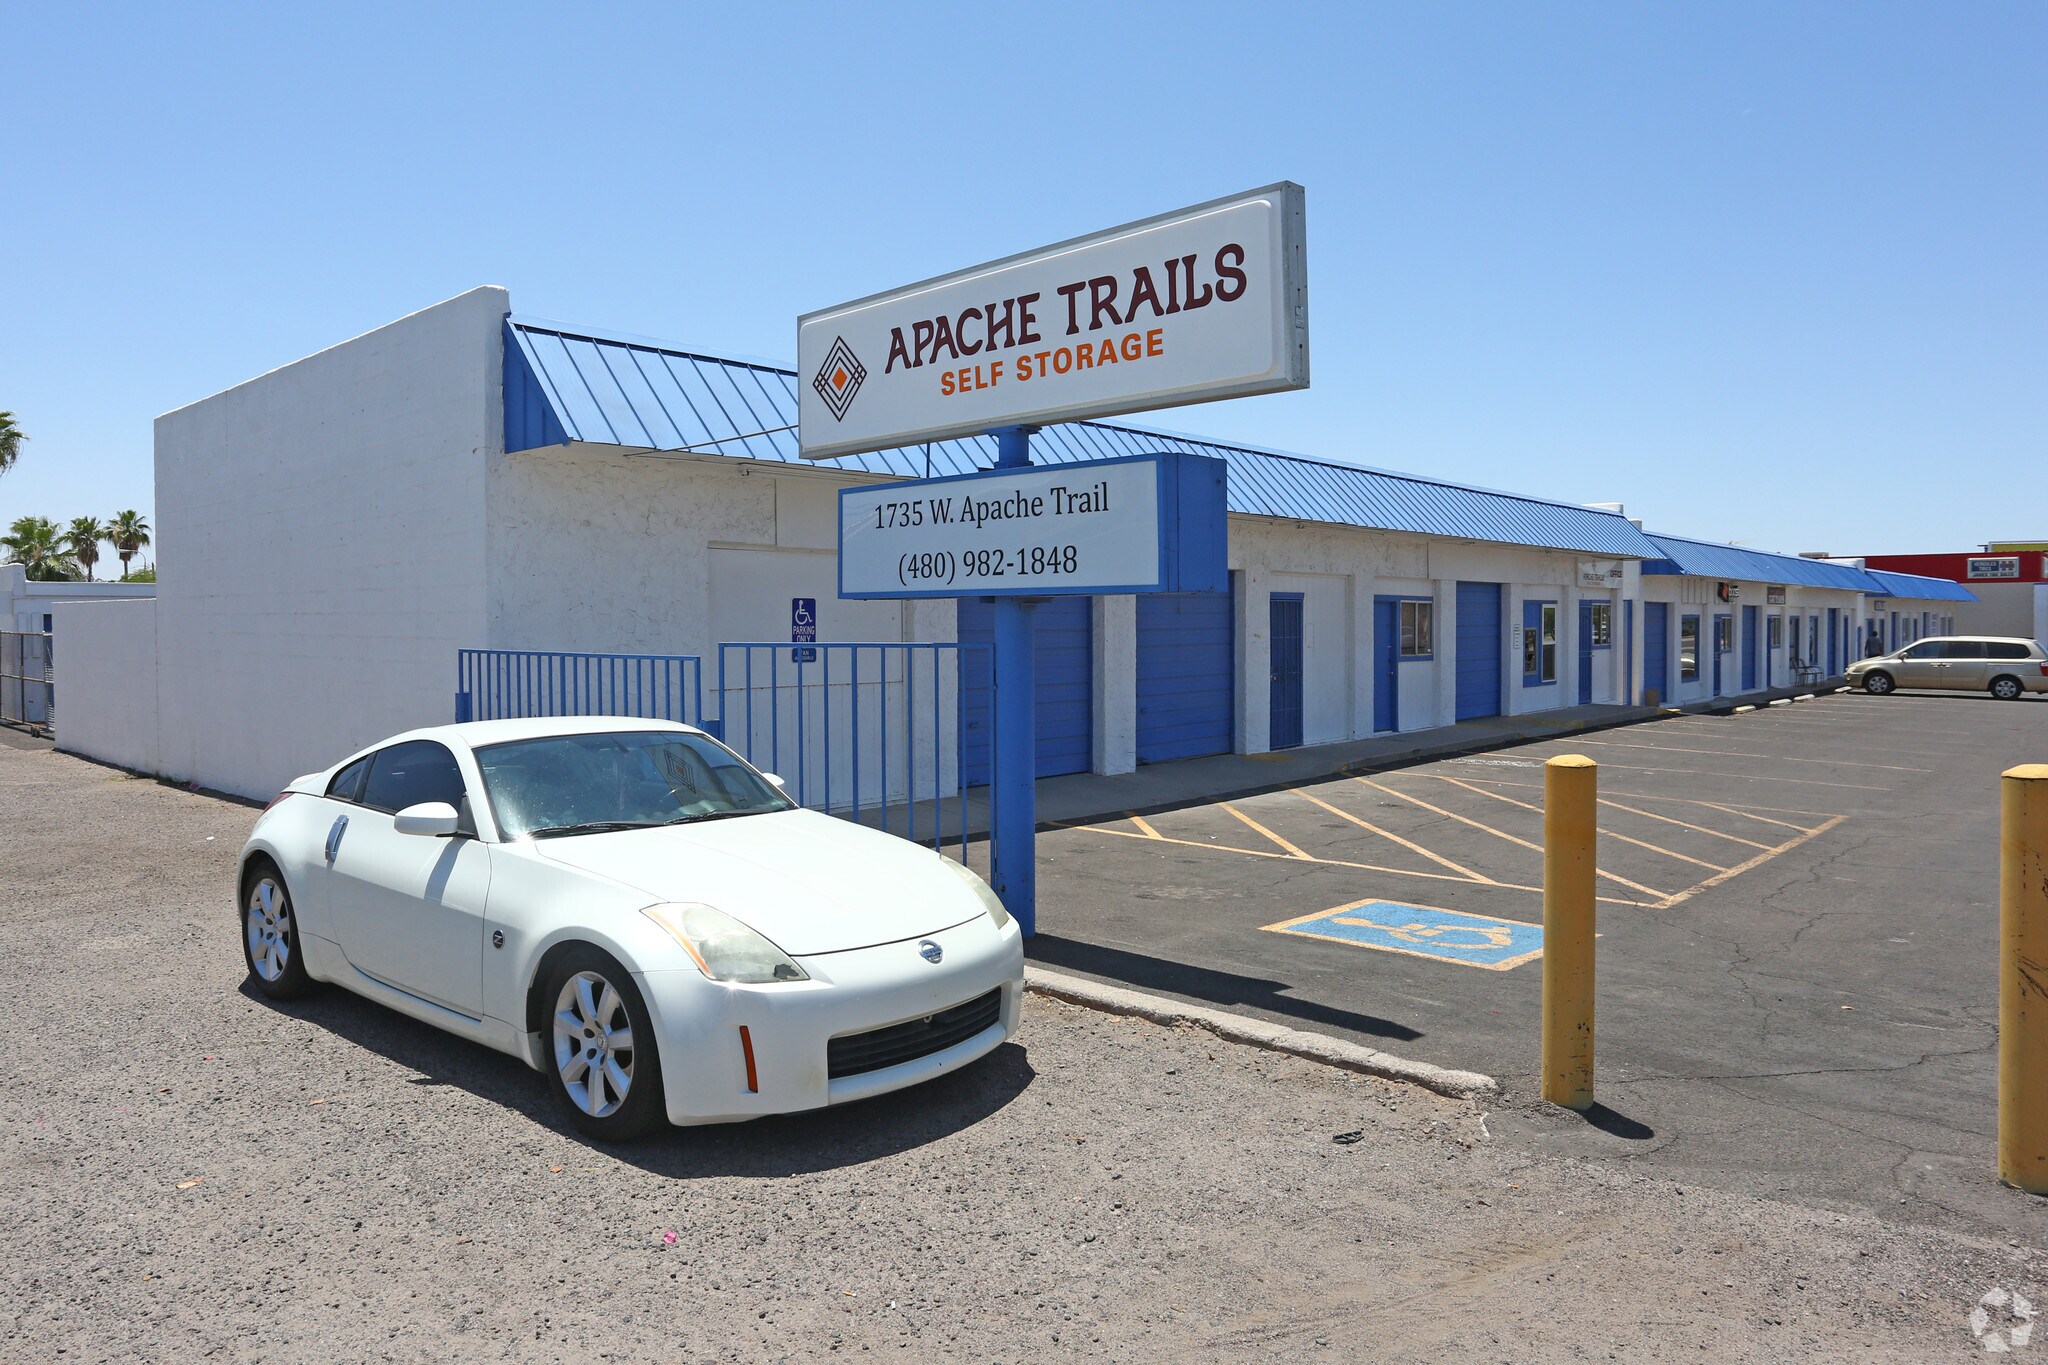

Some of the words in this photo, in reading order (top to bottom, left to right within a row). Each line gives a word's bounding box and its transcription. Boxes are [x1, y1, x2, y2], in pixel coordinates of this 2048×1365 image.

[884, 292, 1041, 375] APACHE
[1057, 243, 1248, 336] TRAILS
[940, 361, 1003, 396] SELF
[1016, 328, 1164, 381] STORAGE
[875, 500, 923, 529] 1735
[929, 498, 954, 525] W.
[959, 490, 1043, 529] Apache
[1050, 481, 1109, 515] Trail
[899, 551, 956, 587] (480)
[963, 545, 1078, 577] 982-1848
[792, 625, 815, 635] PARKING
